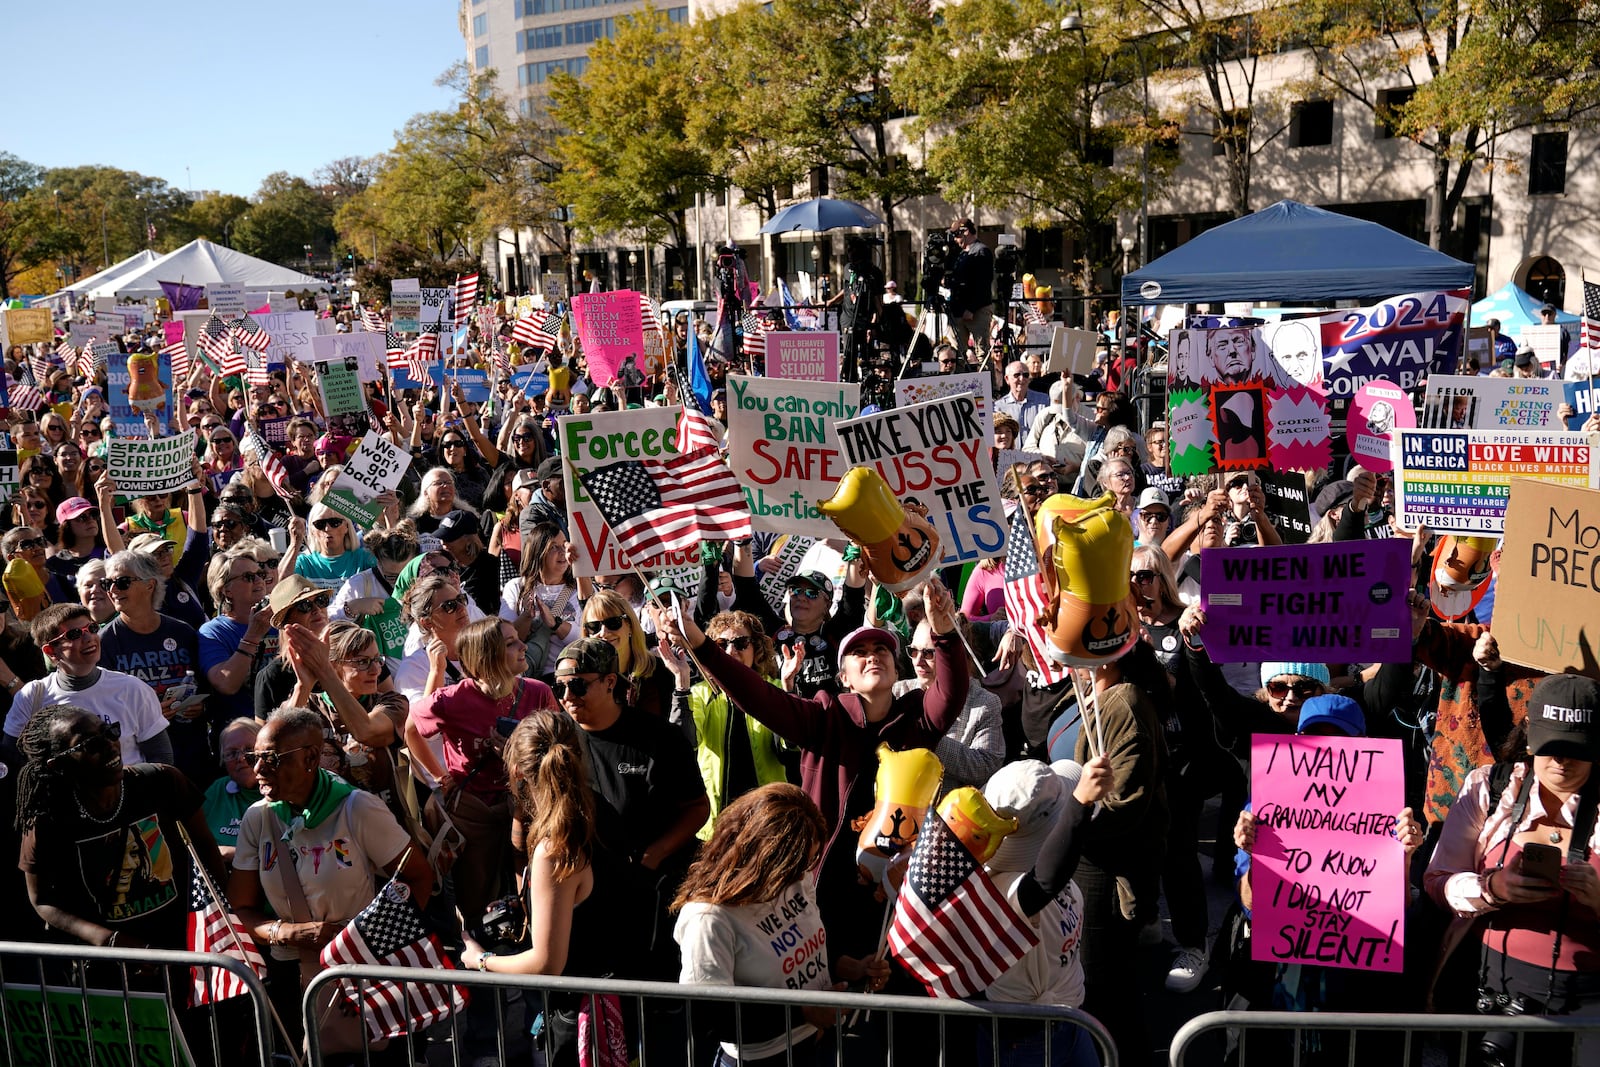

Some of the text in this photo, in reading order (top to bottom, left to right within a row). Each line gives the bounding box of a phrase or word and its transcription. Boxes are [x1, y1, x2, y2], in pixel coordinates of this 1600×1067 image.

[422, 289, 451, 298] BLACK
[422, 299, 442, 307] JOB
[583, 294, 617, 303] DON'T
[583, 303, 607, 312] LET
[584, 312, 620, 321] THEM
[1343, 294, 1451, 338] 2024
[259, 313, 293, 331] VOTE
[586, 321, 618, 329] TAKE
[586, 329, 617, 338] YOUR
[588, 338, 631, 346] POWER
[780, 348, 825, 361] WOMEN
[780, 362, 825, 376] SELDOM
[730, 379, 858, 419] You can only
[1437, 387, 1474, 396] FELON
[1507, 386, 1550, 396] SUPER
[1495, 409, 1550, 418] FASCIST
[1501, 400, 1553, 410] FUKING
[764, 413, 826, 444] BAN
[837, 397, 984, 464] TAKE YOUR
[1176, 423, 1193, 434] NOT
[1277, 417, 1320, 426] GOING
[1499, 417, 1549, 426] RACIST
[128, 430, 195, 454] FAMILIES
[375, 437, 396, 459] We
[1404, 437, 1466, 454] IN OUR
[1494, 436, 1529, 444] PEOPLE
[1559, 437, 1590, 446] EQUAL
[110, 442, 127, 467] OUR
[127, 444, 194, 468] FREEDOMS
[361, 444, 399, 473] won't
[745, 439, 841, 485] SAFE
[1405, 455, 1466, 469] AMERICA
[1471, 445, 1589, 463] LOVE WINS
[109, 460, 193, 479] OUR FUTURES
[367, 463, 388, 478] go
[875, 438, 982, 497] USSY
[1404, 472, 1458, 481] IMMIGRANTS
[1462, 474, 1468, 482] &
[1471, 463, 1589, 474] BLACK LIVES MATTER
[165, 471, 194, 489] MARCH
[1407, 483, 1509, 496] DISABILITIES ARE
[934, 480, 990, 511] THE
[1265, 483, 1304, 502] BE a MAN
[1405, 495, 1505, 507] WOMEN ARE IN CHARGE
[328, 491, 375, 520] WOMEN'S MARCH
[1407, 504, 1435, 513] PEOPLE
[1447, 507, 1476, 516] PLANET
[1293, 518, 1311, 534] for a
[1404, 514, 1492, 529] DIVERSITY IS
[903, 540, 932, 573] RESIST
[1222, 552, 1366, 582] WHEN WE
[1258, 591, 1344, 616] FIGHT
[383, 625, 406, 641] OFF
[1088, 632, 1131, 651] RESIST
[1228, 624, 1362, 648] WE WIN!
[116, 648, 191, 671] HARRIS
[1542, 703, 1594, 725] DETROIT
[1266, 742, 1384, 783] I WANT
[1303, 782, 1347, 807] MY
[1257, 802, 1399, 838] GRANDDAUGHTER
[1283, 847, 1377, 877] TO KNOW
[1272, 879, 1371, 912] I DID NOT
[756, 892, 808, 936] WE ARE
[1303, 909, 1353, 933] STAY
[770, 922, 805, 958] NOT
[1271, 919, 1399, 967] SILENT!
[782, 926, 826, 975] GOING
[785, 952, 827, 990] BACK
